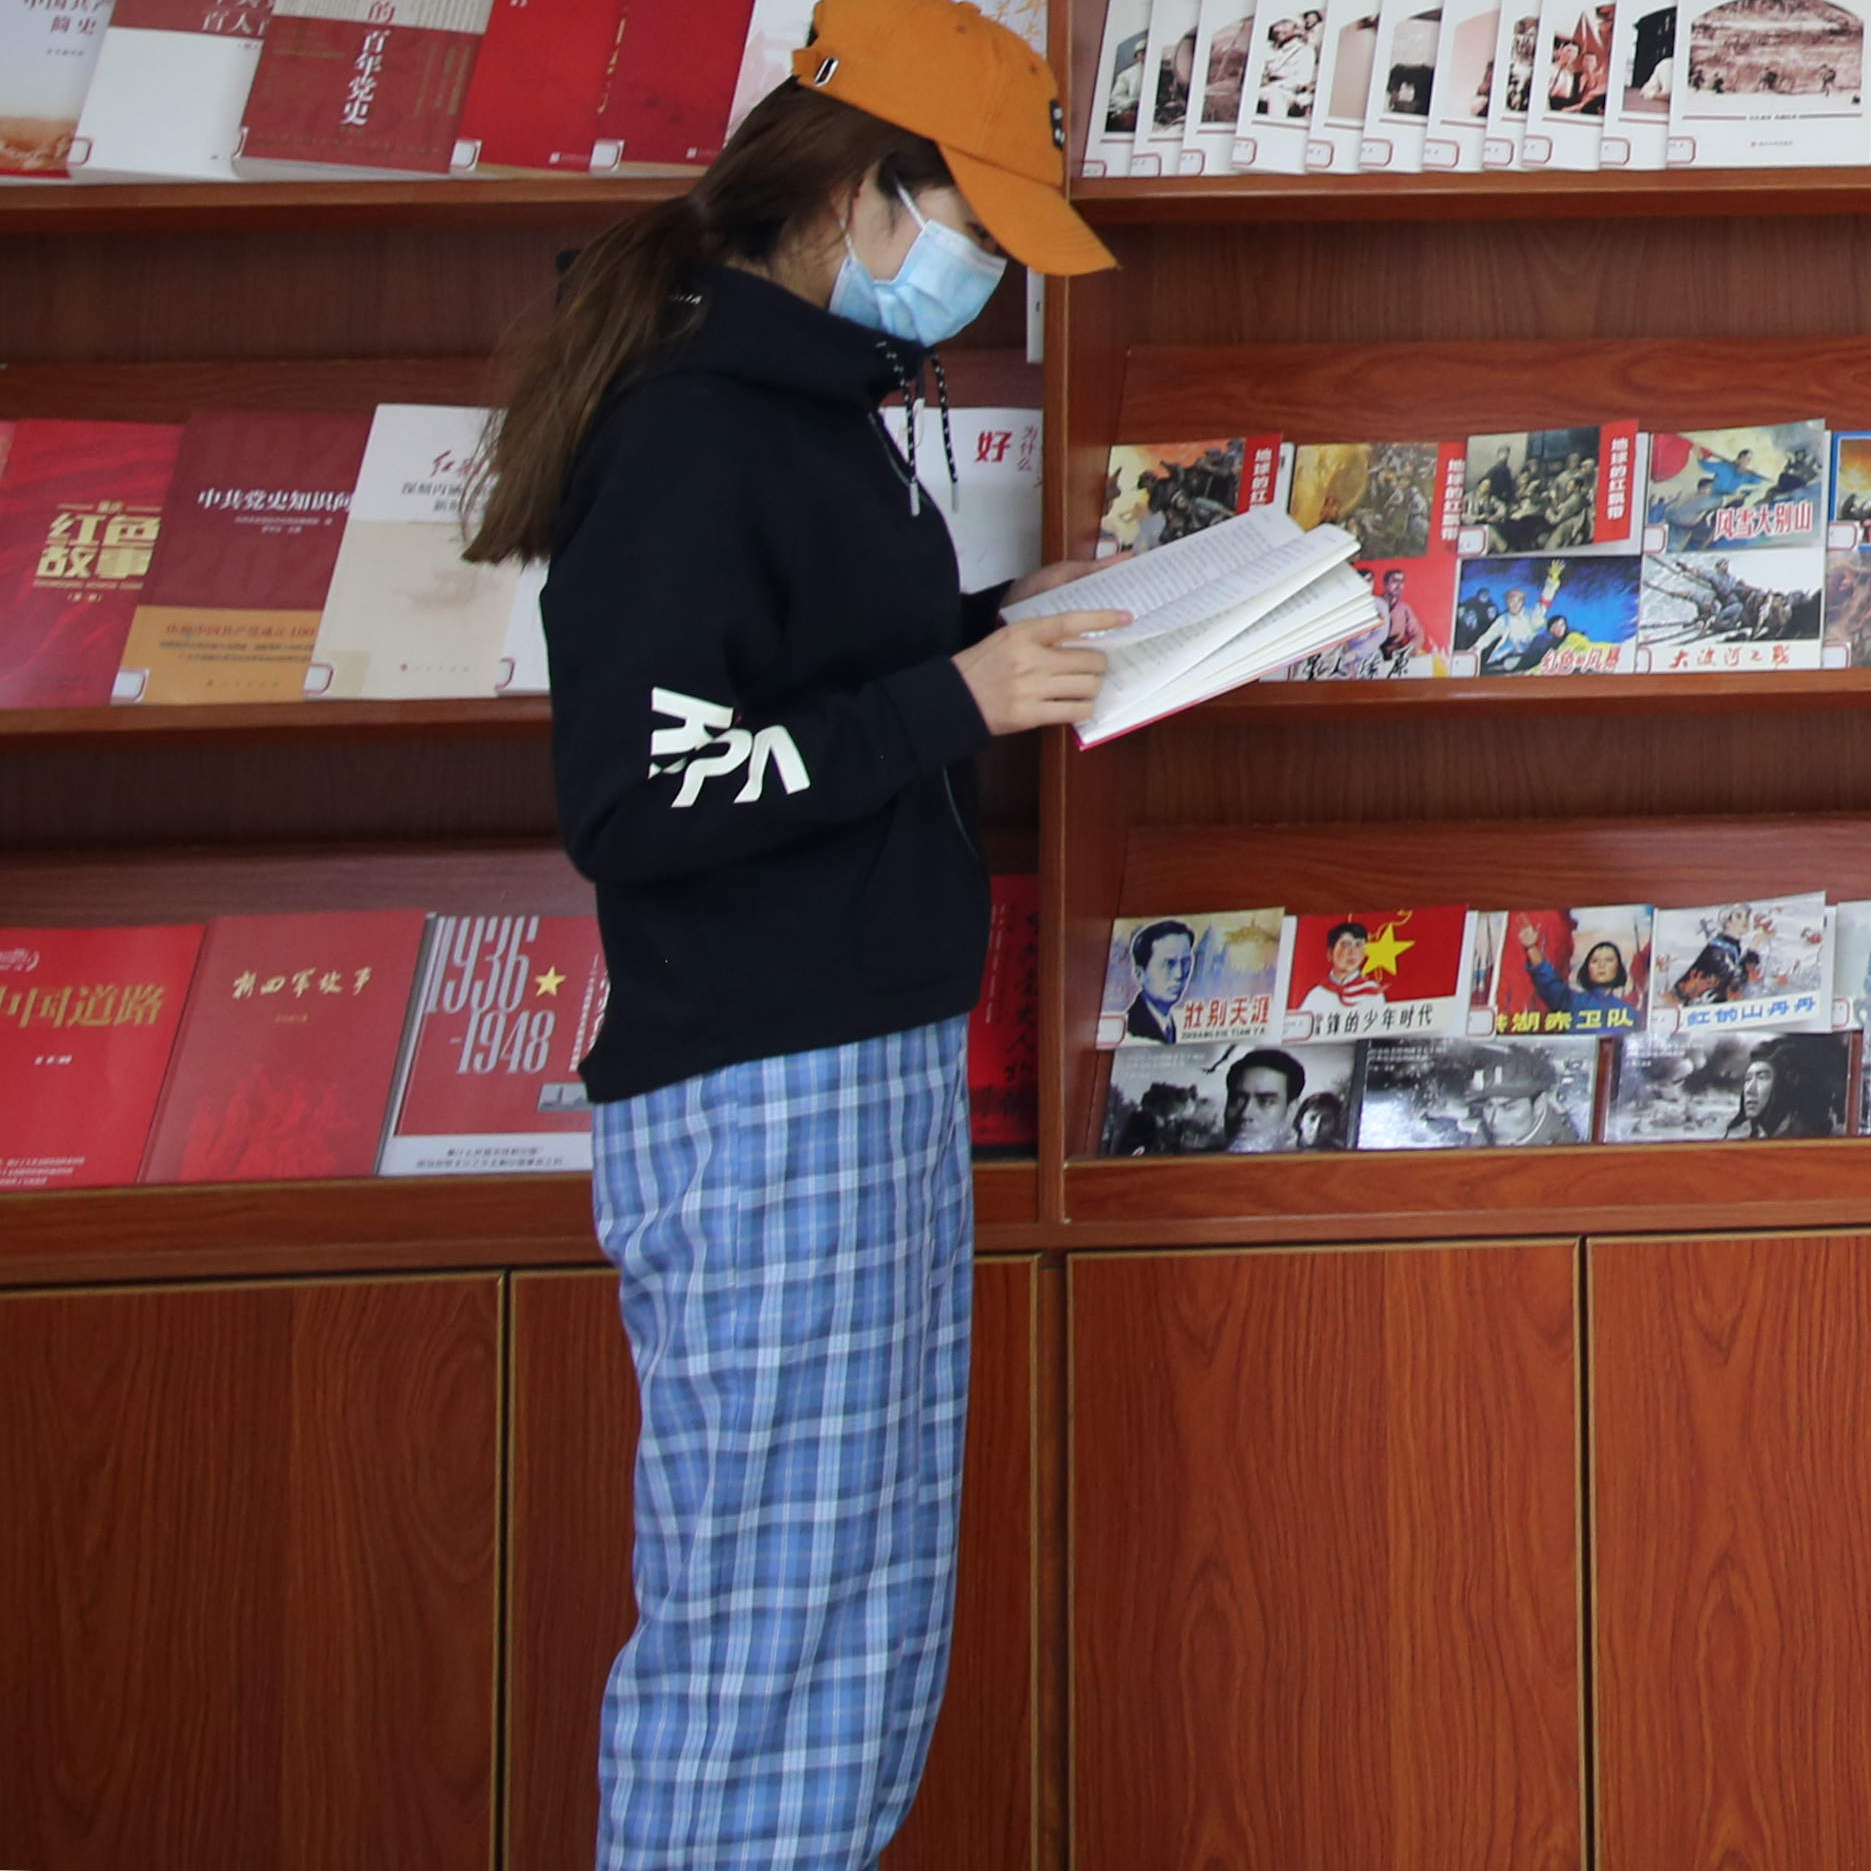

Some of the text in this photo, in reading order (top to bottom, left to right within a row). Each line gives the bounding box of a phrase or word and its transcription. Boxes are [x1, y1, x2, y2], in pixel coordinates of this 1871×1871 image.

[975, 430, 1013, 463] 好
[1017, 424, 1038, 472] 为什么
[1248, 447, 1274, 510] 地球的红
[1605, 437, 1630, 521] 地球的红飘带
[46, 513, 162, 546] 红色
[1713, 501, 1814, 541] 风雪大别山
[35, 545, 155, 581] 故事
[424, 915, 541, 1015] 1936
